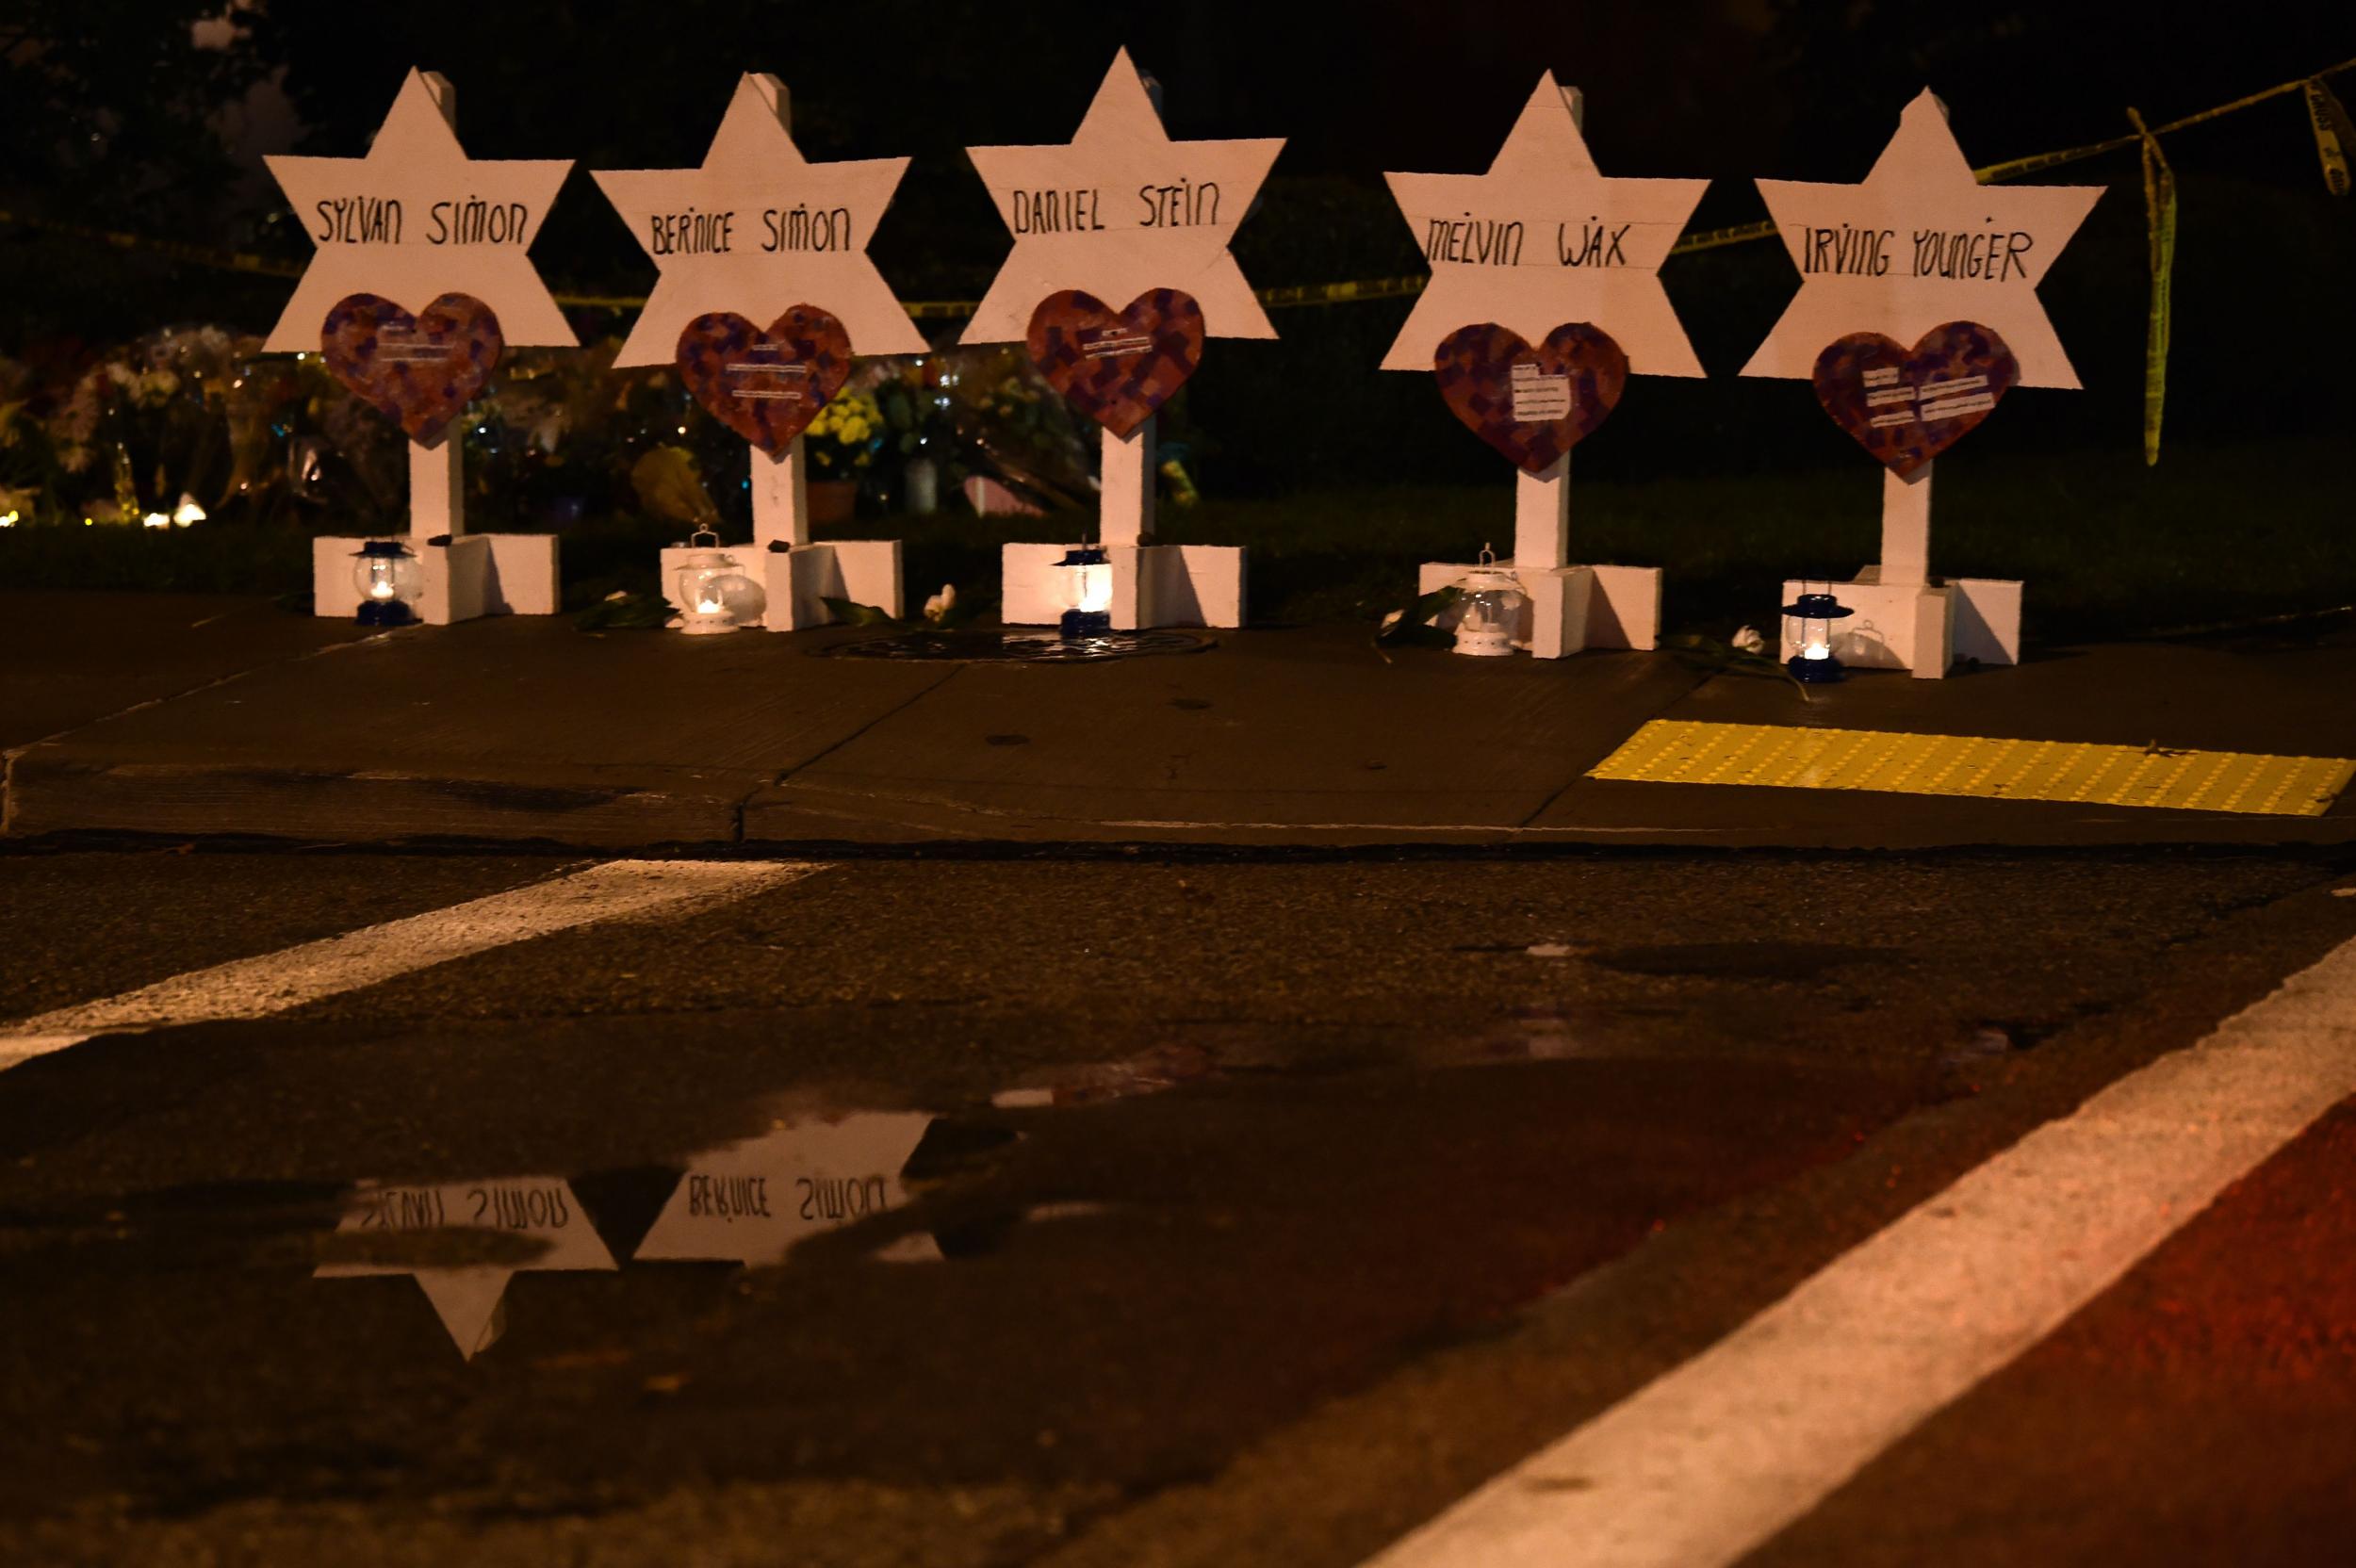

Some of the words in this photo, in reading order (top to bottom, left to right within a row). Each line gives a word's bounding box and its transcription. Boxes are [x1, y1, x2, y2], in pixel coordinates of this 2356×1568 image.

[317, 195, 401, 245] SYLVAN
[426, 194, 528, 245] SIMON
[650, 206, 735, 254] BERNICE
[761, 202, 850, 253] SIMON
[1013, 188, 1104, 235] DANIEL
[1138, 177, 1219, 228] STEIN
[1426, 211, 1523, 267] MELVIN
[1558, 215, 1630, 268] WAX
[1804, 222, 1894, 276] IRVING
[1913, 216, 2033, 282] YOUNGER
